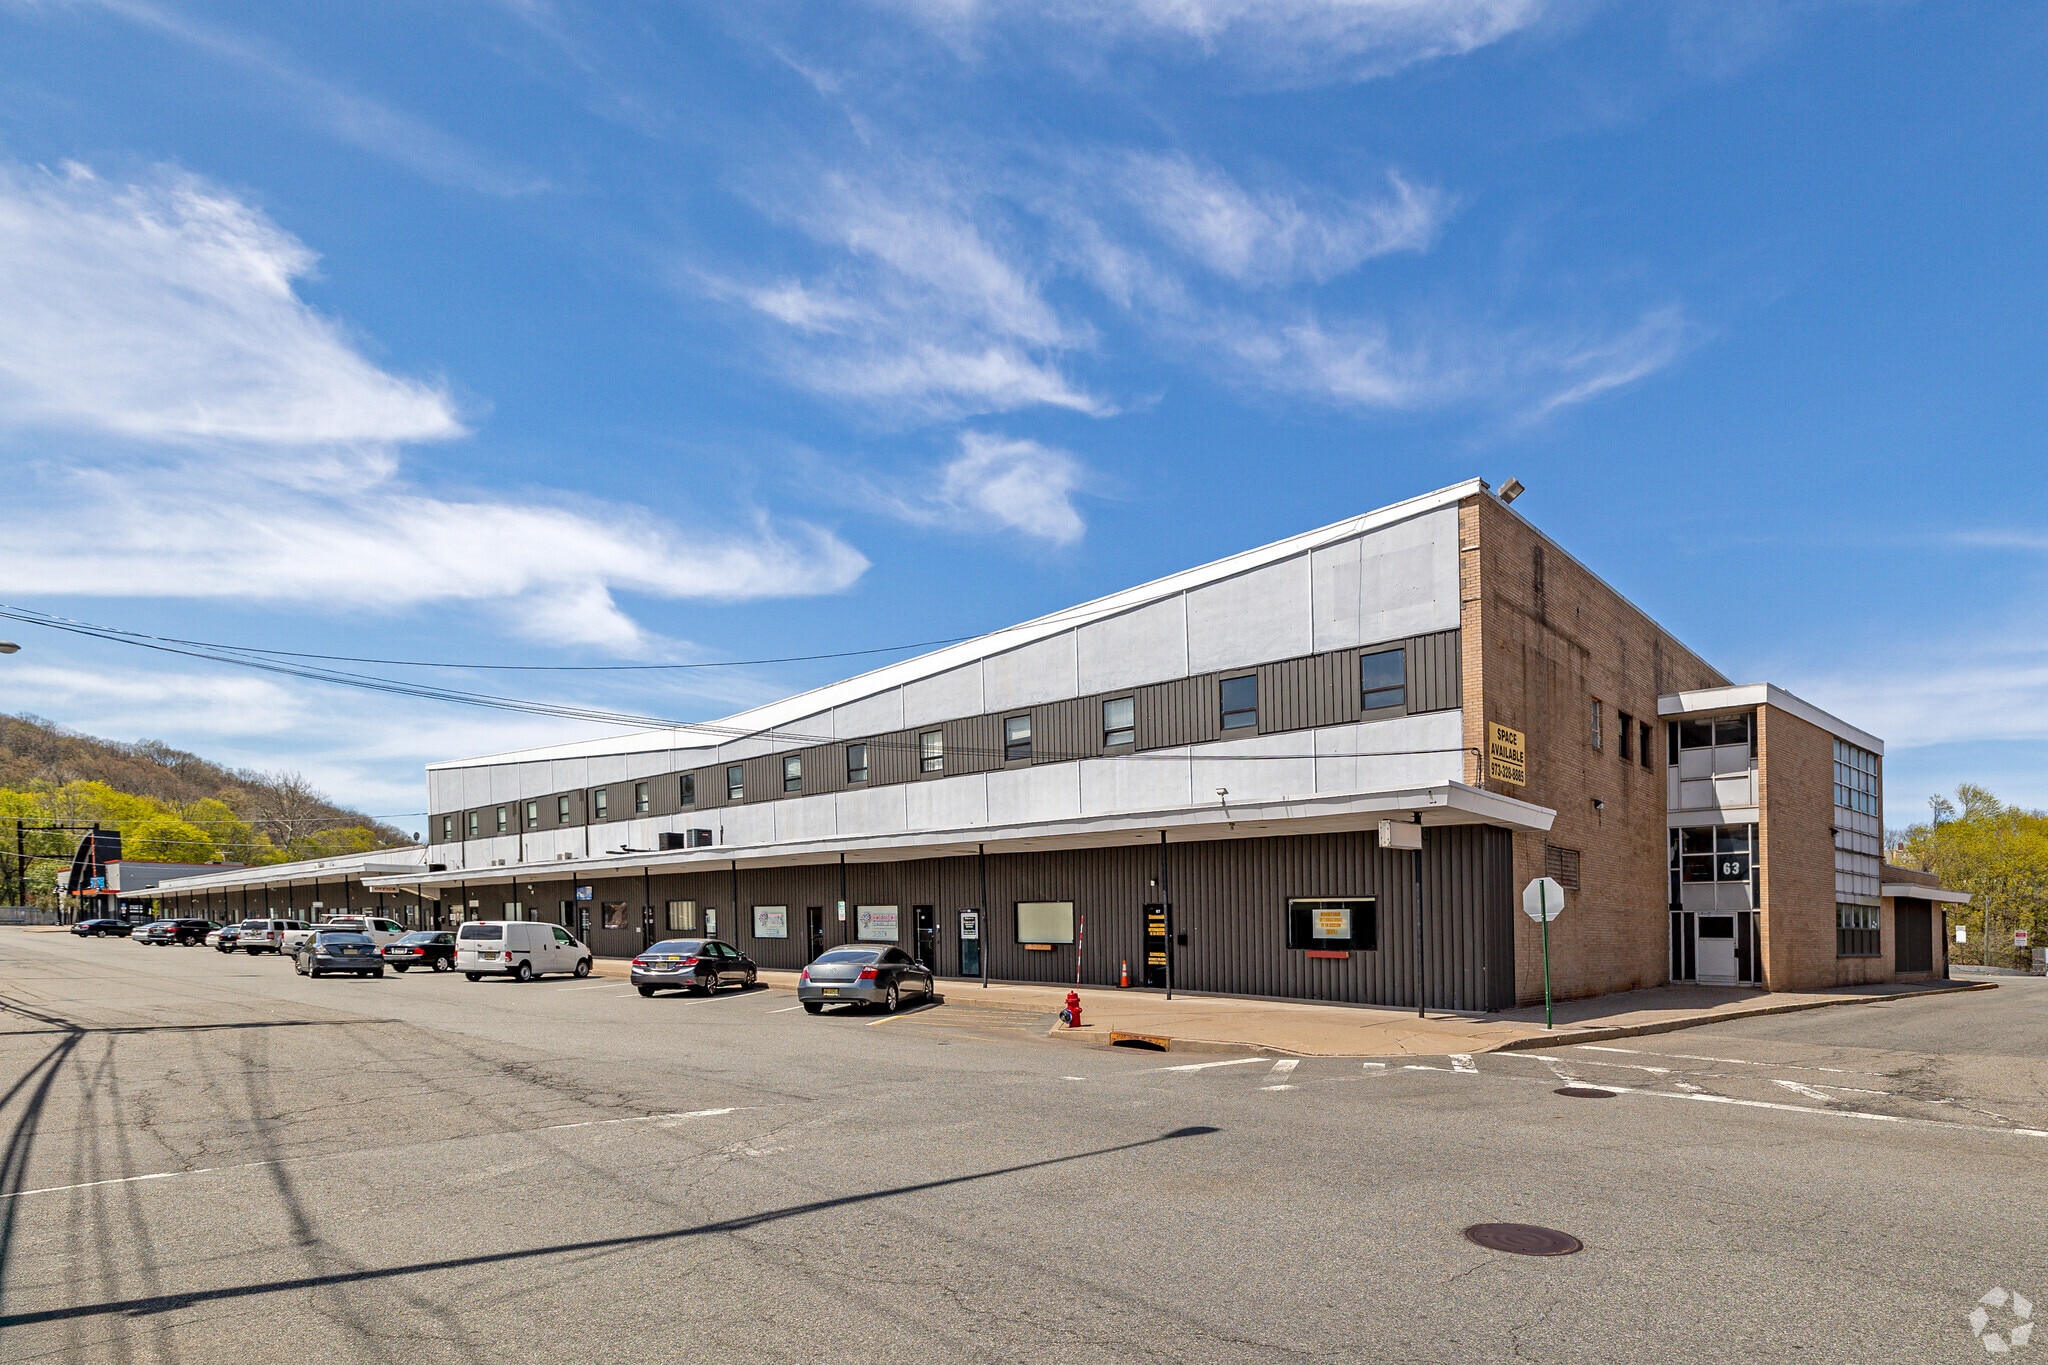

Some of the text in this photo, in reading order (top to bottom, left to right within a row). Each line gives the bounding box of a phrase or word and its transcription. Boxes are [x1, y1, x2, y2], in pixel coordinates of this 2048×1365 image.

[1497, 728, 1517, 745] SPACE
[1491, 743, 1524, 763] AVAILABLE
[1723, 862, 1740, 875] 63
